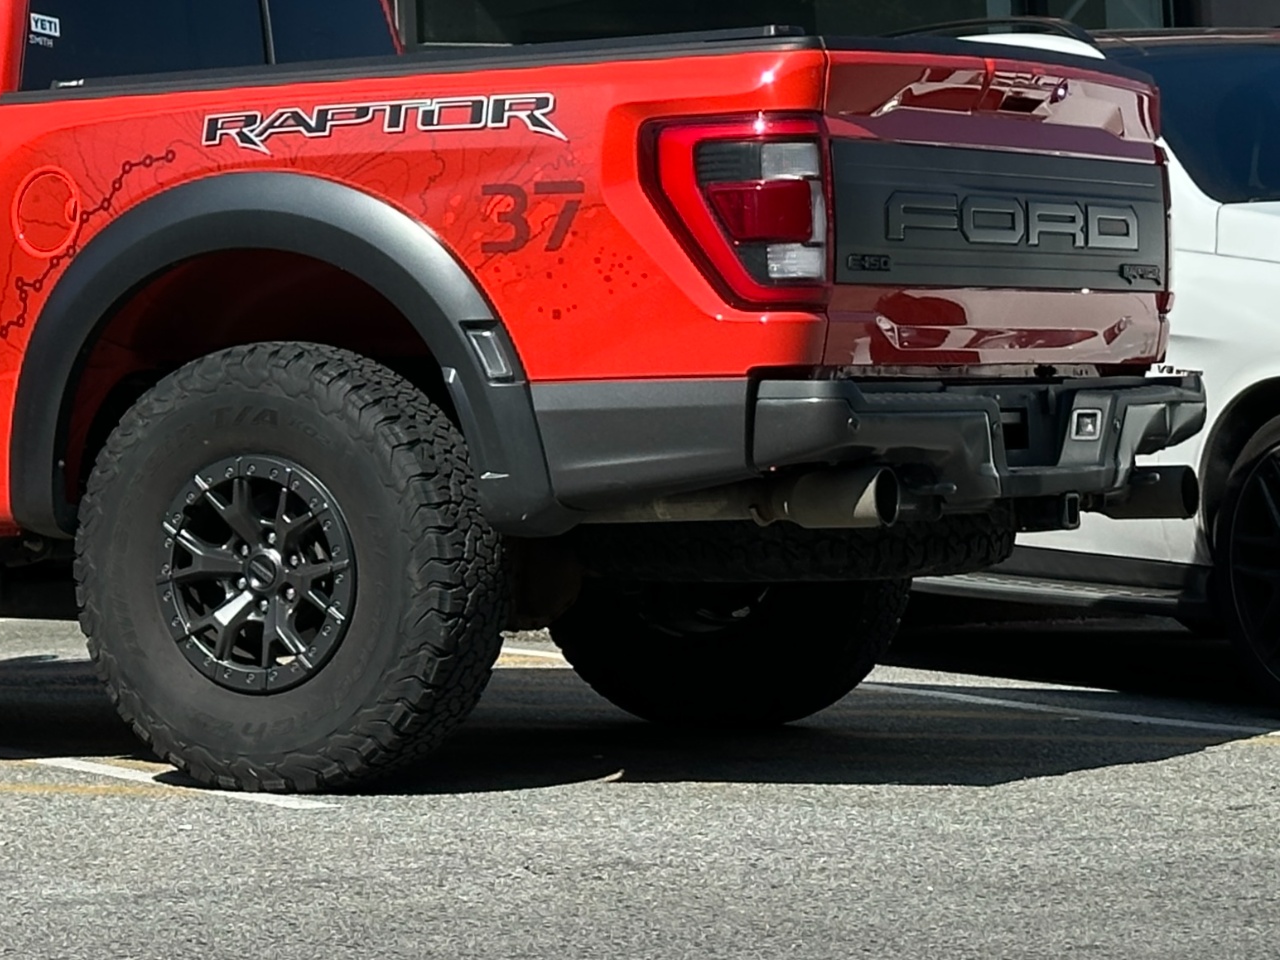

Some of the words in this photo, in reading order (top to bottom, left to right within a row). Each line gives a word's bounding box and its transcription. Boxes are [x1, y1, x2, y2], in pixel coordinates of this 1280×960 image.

[31, 15, 58, 34] YETI
[202, 92, 568, 154] RAPTOR
[481, 180, 585, 255] 37
[884, 190, 1139, 251] FORD
